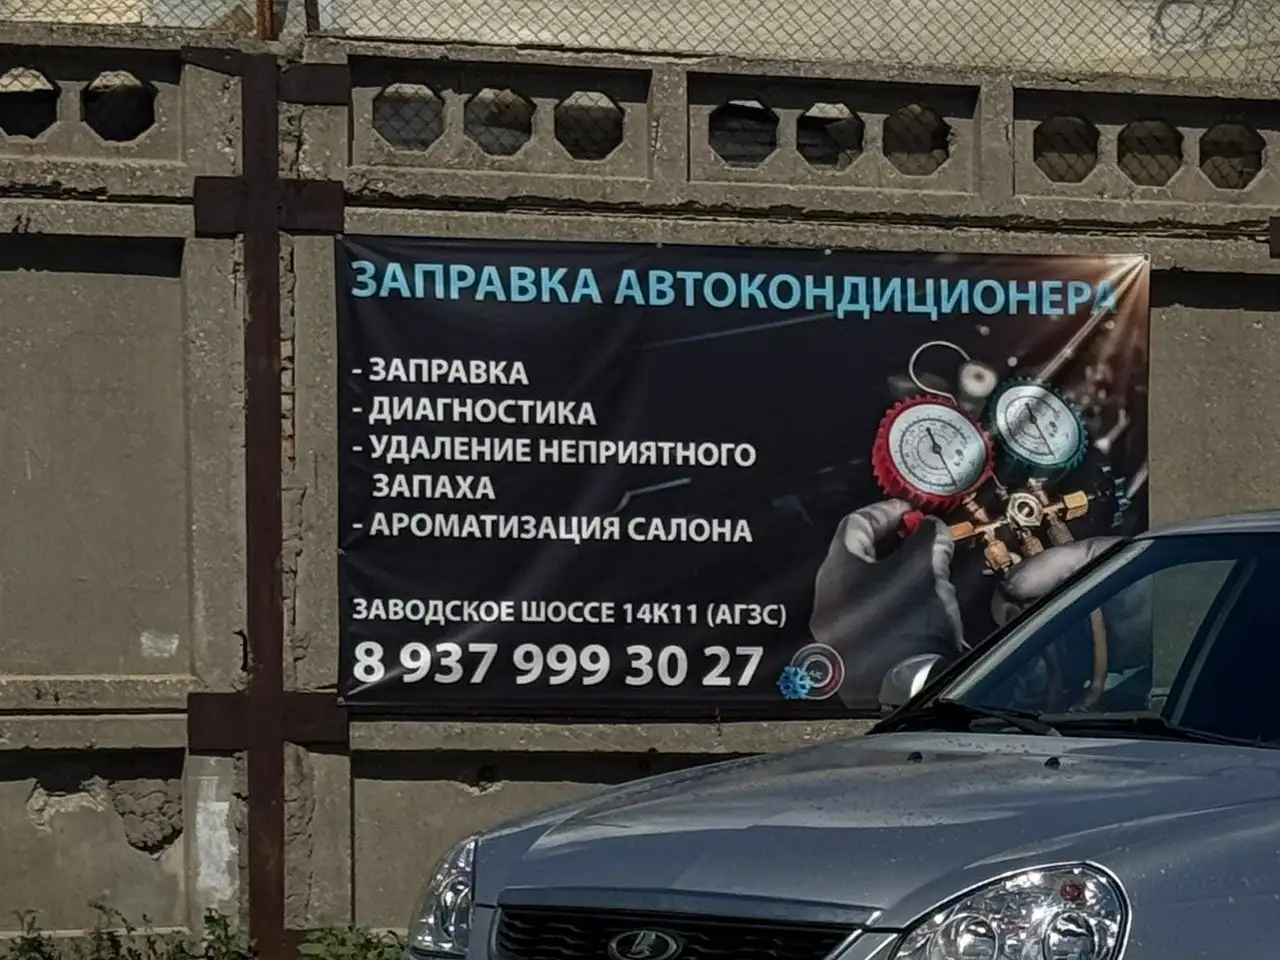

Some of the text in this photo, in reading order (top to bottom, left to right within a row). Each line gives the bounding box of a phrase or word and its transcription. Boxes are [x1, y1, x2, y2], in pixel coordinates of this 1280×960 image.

[352, 261, 1118, 321] ЗАПРАВКА АВТОКОНДИЦИОНЕРА
[370, 357, 528, 384] ЗАПРАВКА
[369, 396, 596, 425] ДИАГНОСТИКА
[369, 435, 756, 466] УДАЛЕНИЕ НЕПРИЯТНОГО
[373, 474, 495, 499] ЗАПАХА
[370, 513, 752, 544] АРОМАТИЗАЦИЯ САЛОНА
[353, 598, 786, 627] ЗАВОДСКОЕ ШОССЕ 14К11 (АГЗС)
[353, 641, 763, 685] 8 937 999 30 27
